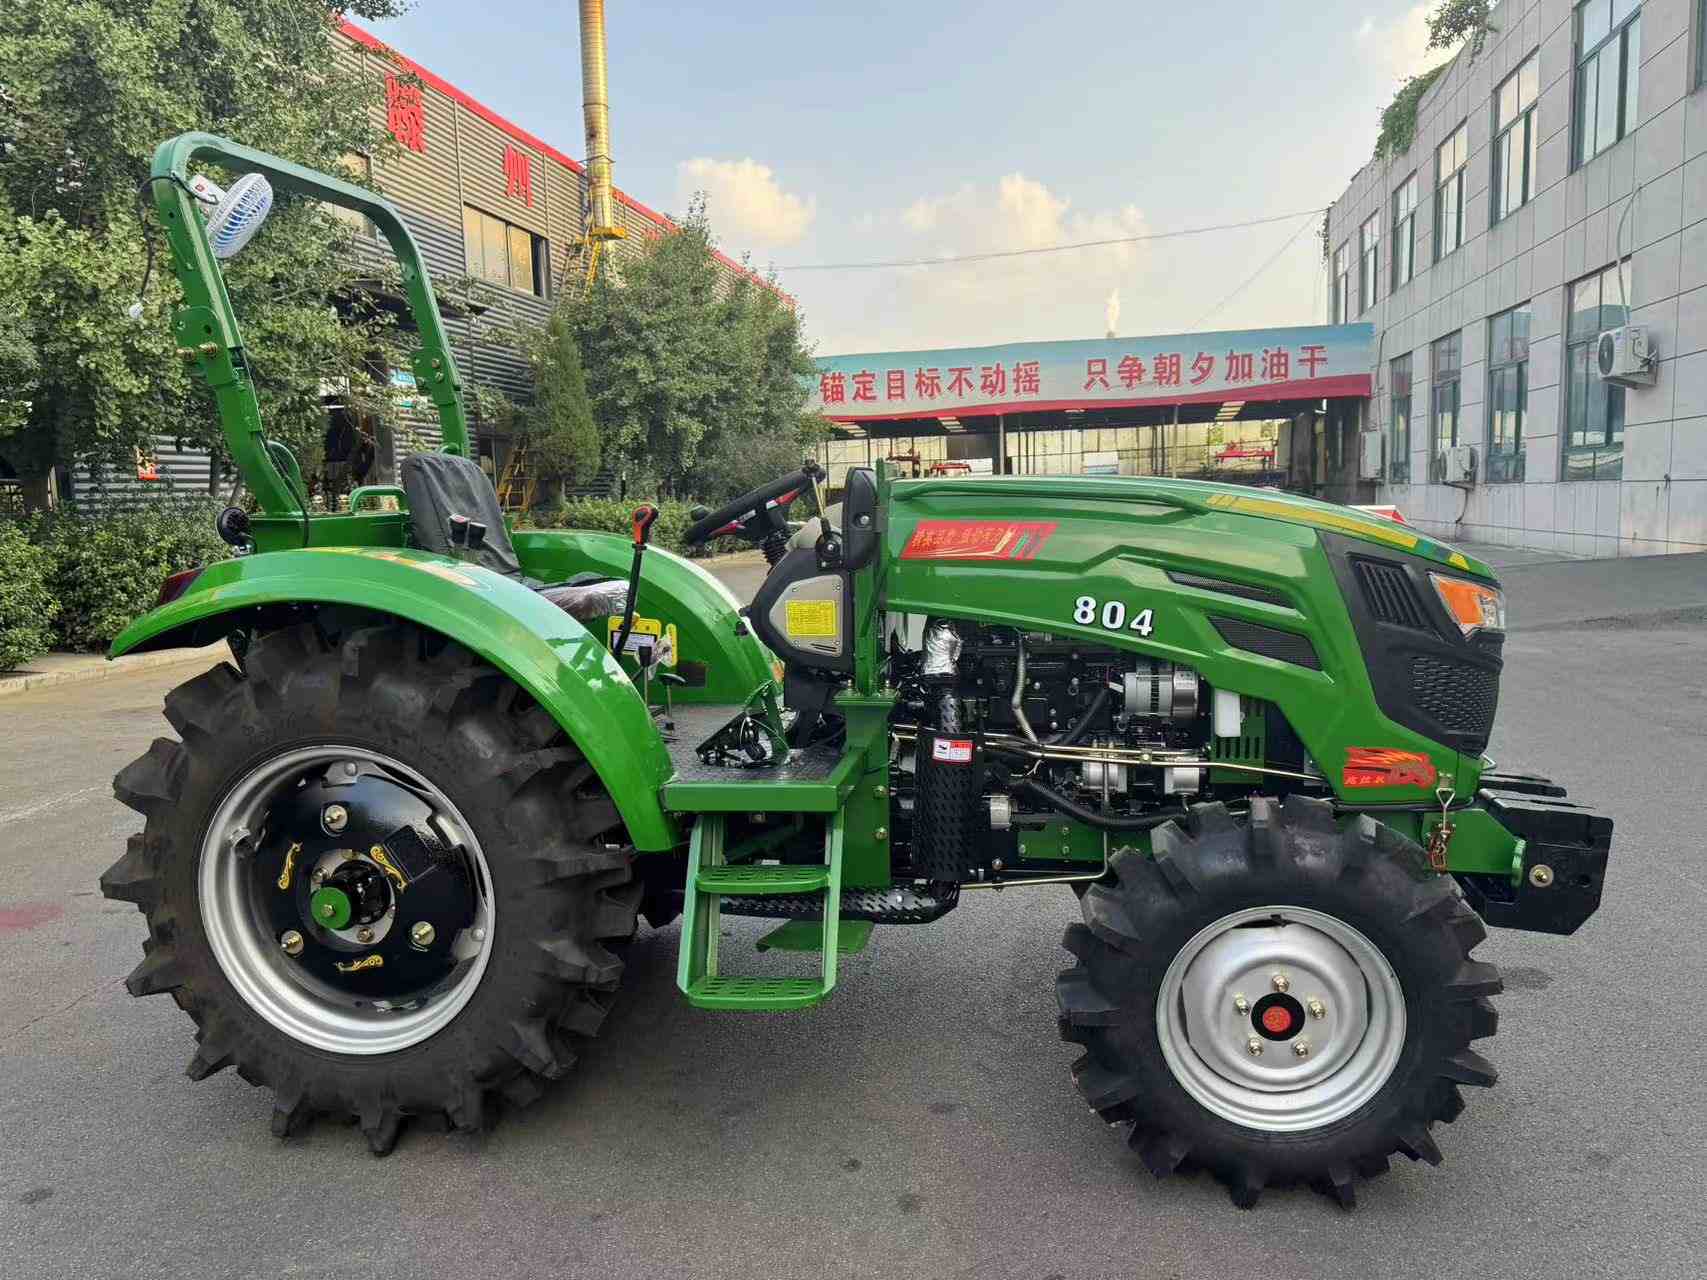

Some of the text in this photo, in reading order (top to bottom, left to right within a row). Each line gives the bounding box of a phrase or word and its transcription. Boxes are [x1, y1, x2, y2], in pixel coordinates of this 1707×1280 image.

[819, 345, 1329, 402] 锚定目标不动摇 只争朝夕加油干
[1073, 595, 1153, 637] 804
